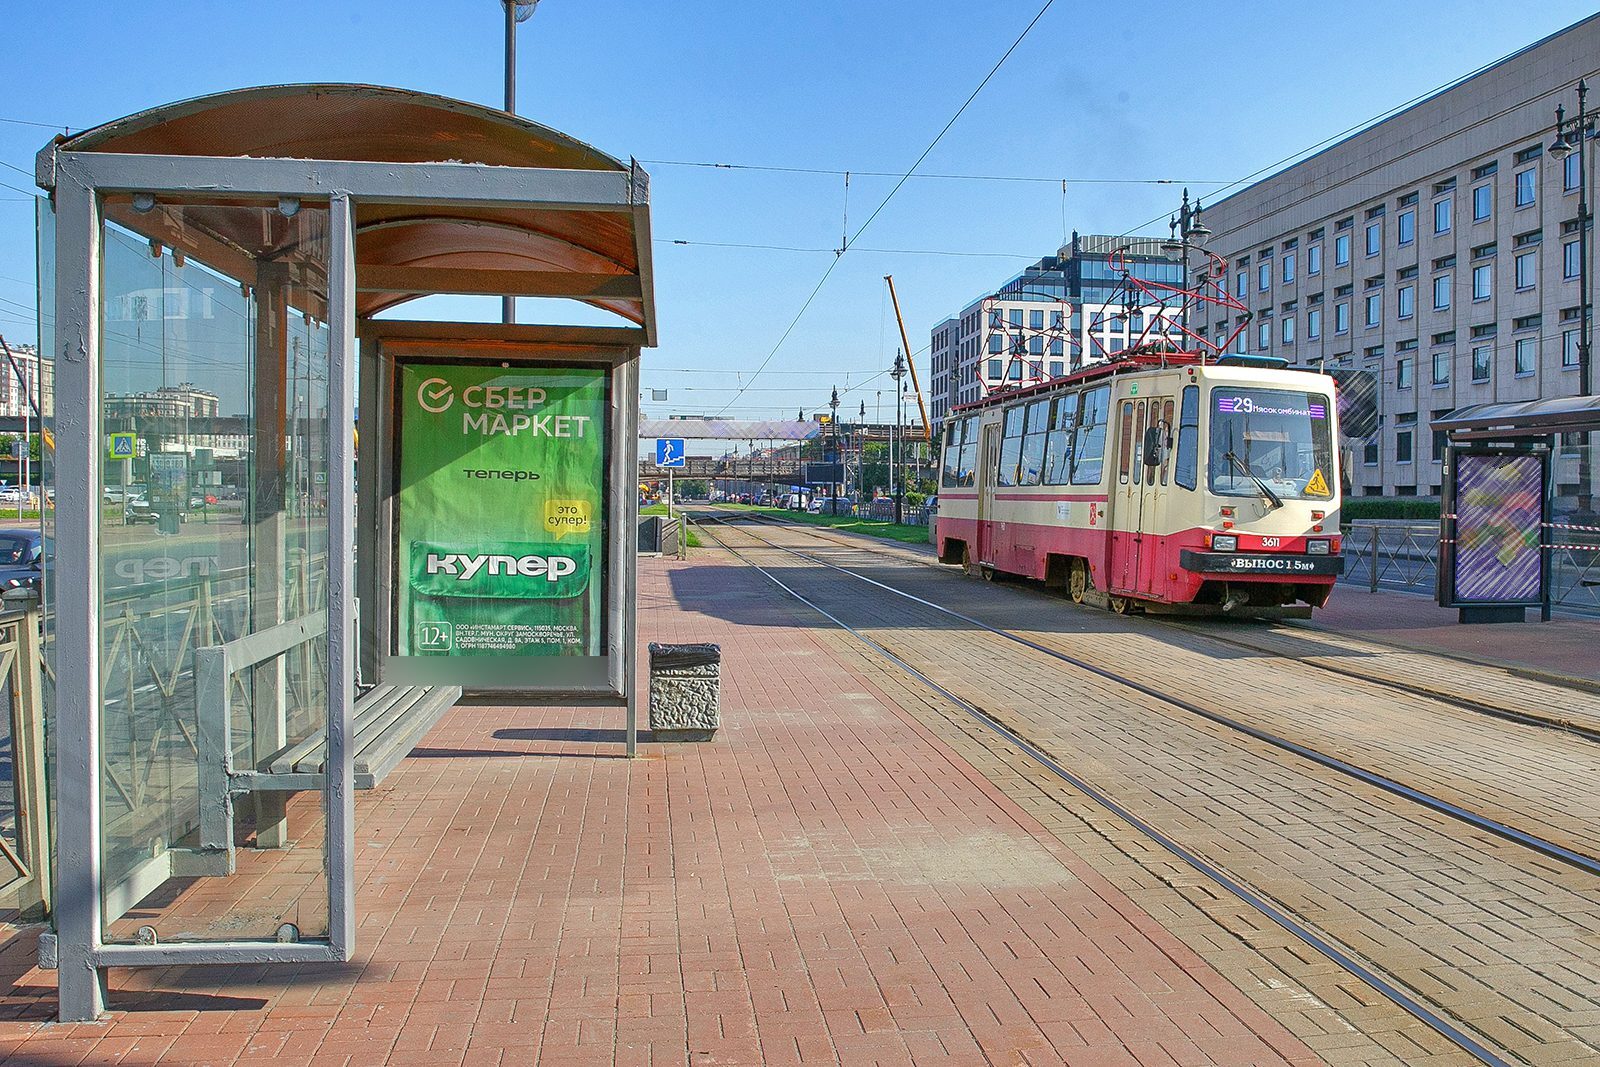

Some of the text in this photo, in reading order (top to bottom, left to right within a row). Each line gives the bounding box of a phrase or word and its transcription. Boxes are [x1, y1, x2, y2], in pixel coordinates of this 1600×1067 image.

[463, 385, 547, 409] СБЕР
[1233, 397, 1253, 413] 29
[463, 412, 590, 438] МАРКЕТ
[463, 469, 540, 482] теперь
[557, 506, 578, 514] это
[548, 515, 587, 525] супер!
[1261, 537, 1280, 547] 3611
[427, 553, 577, 582] купер
[1236, 559, 1284, 569] ВЫНОС
[421, 627, 449, 645] 12+
